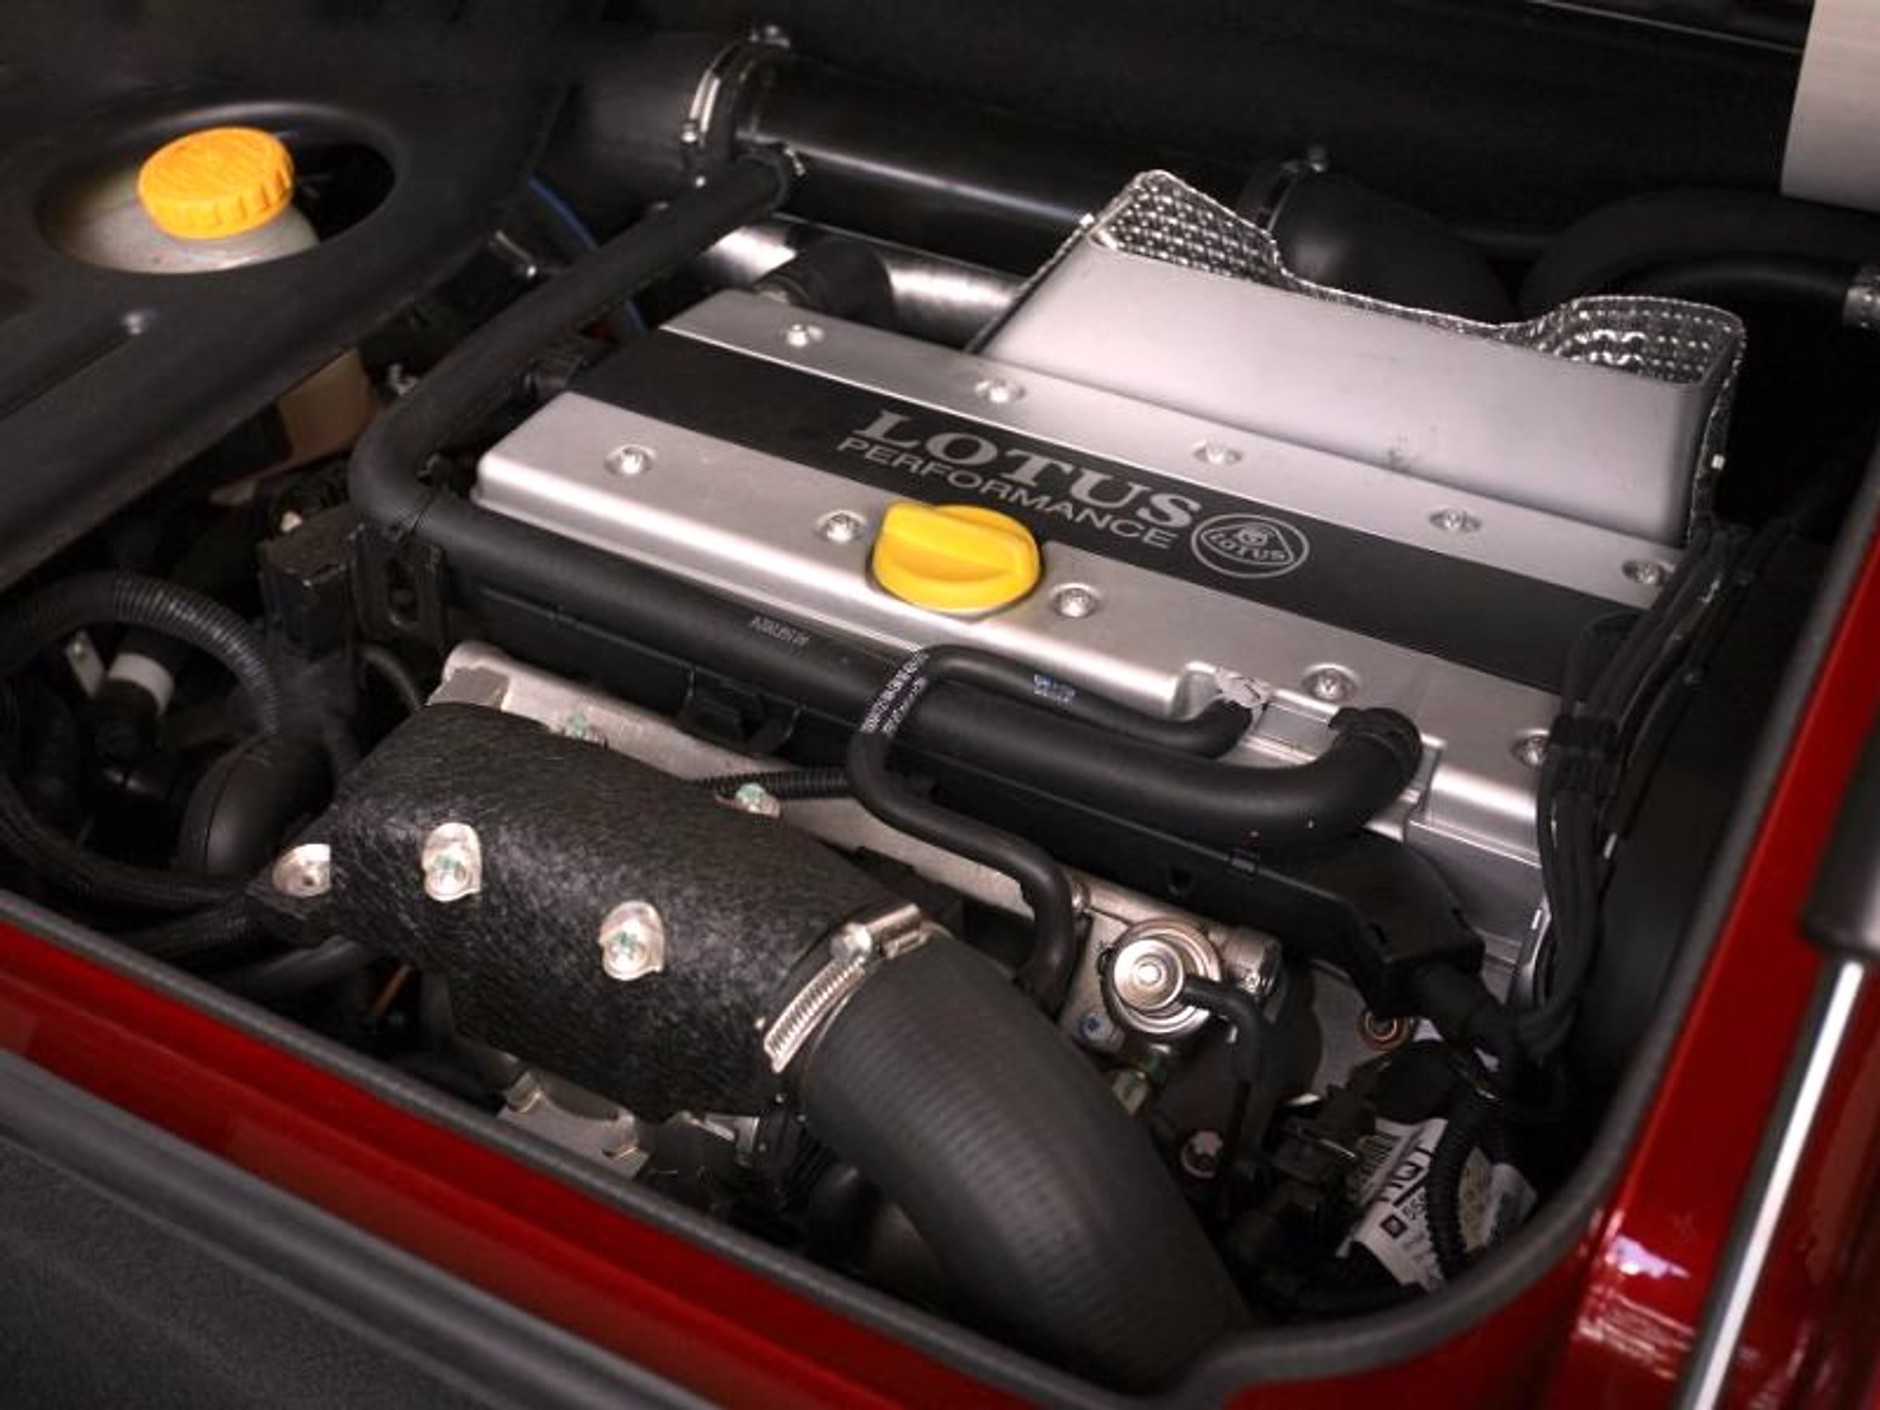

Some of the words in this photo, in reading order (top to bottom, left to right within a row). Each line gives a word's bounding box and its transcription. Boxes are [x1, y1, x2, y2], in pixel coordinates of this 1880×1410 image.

[837, 437, 1183, 550] PERFORMANCE
[854, 410, 1202, 529] LOTUS
[1208, 533, 1286, 561] LOTUS
